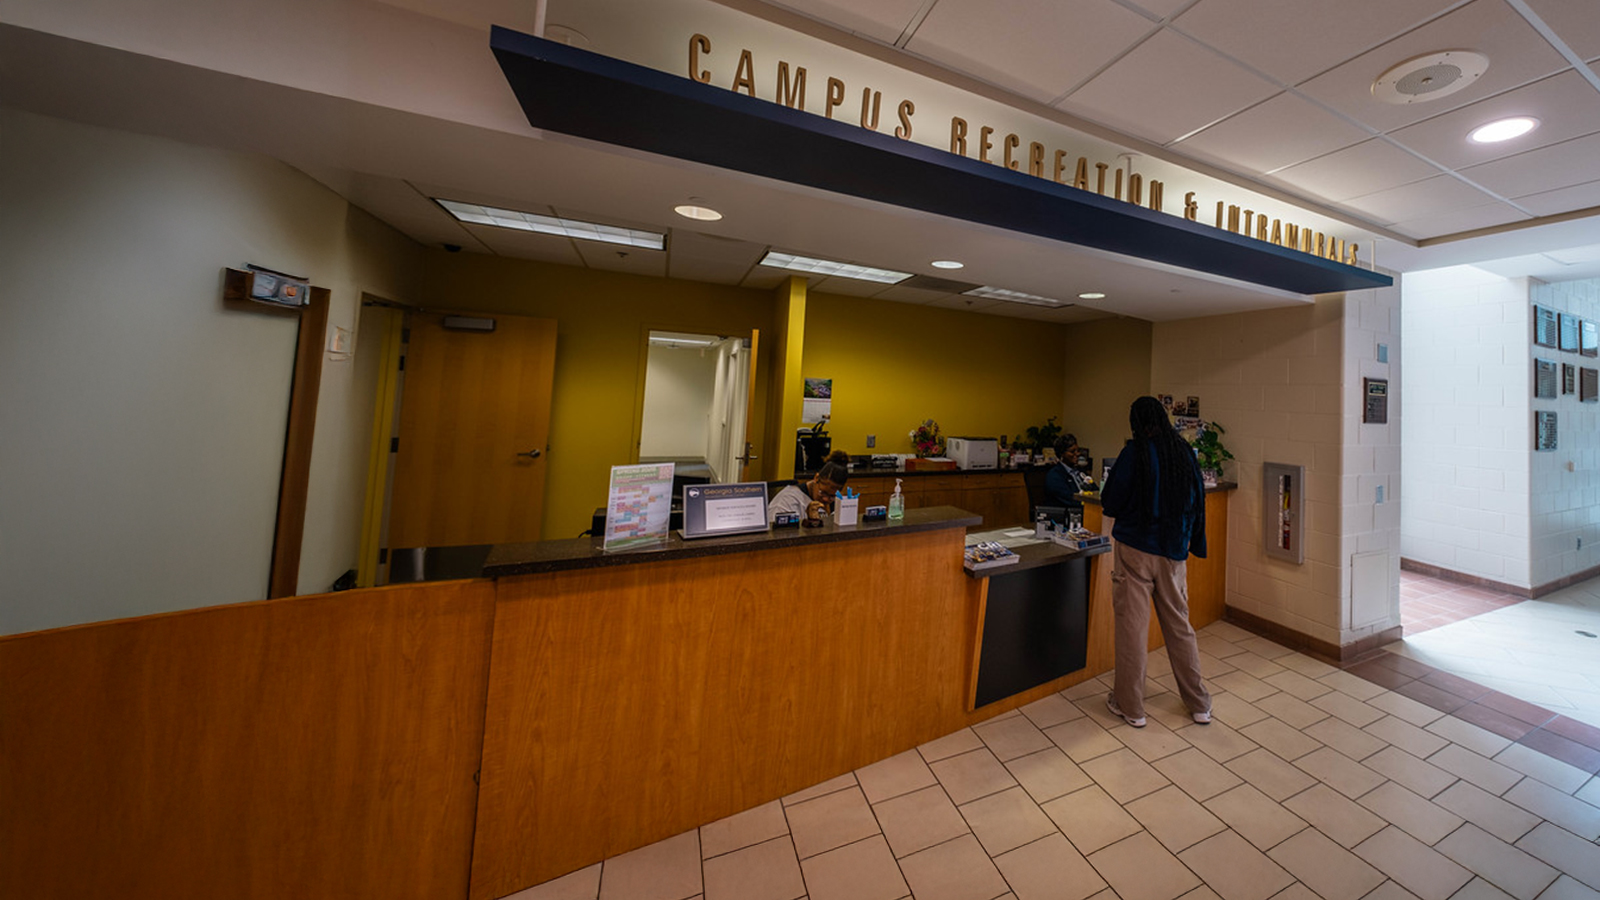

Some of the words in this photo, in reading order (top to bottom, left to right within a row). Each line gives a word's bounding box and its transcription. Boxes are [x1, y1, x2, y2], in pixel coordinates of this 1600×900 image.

[689, 33, 915, 140] CAMPUS
[950, 116, 1164, 211] RECREATION
[1184, 191, 1198, 222] &
[1216, 202, 1359, 265] INTRAMURALS
[704, 488, 732, 496] Georgia
[734, 486, 763, 495] Southern
